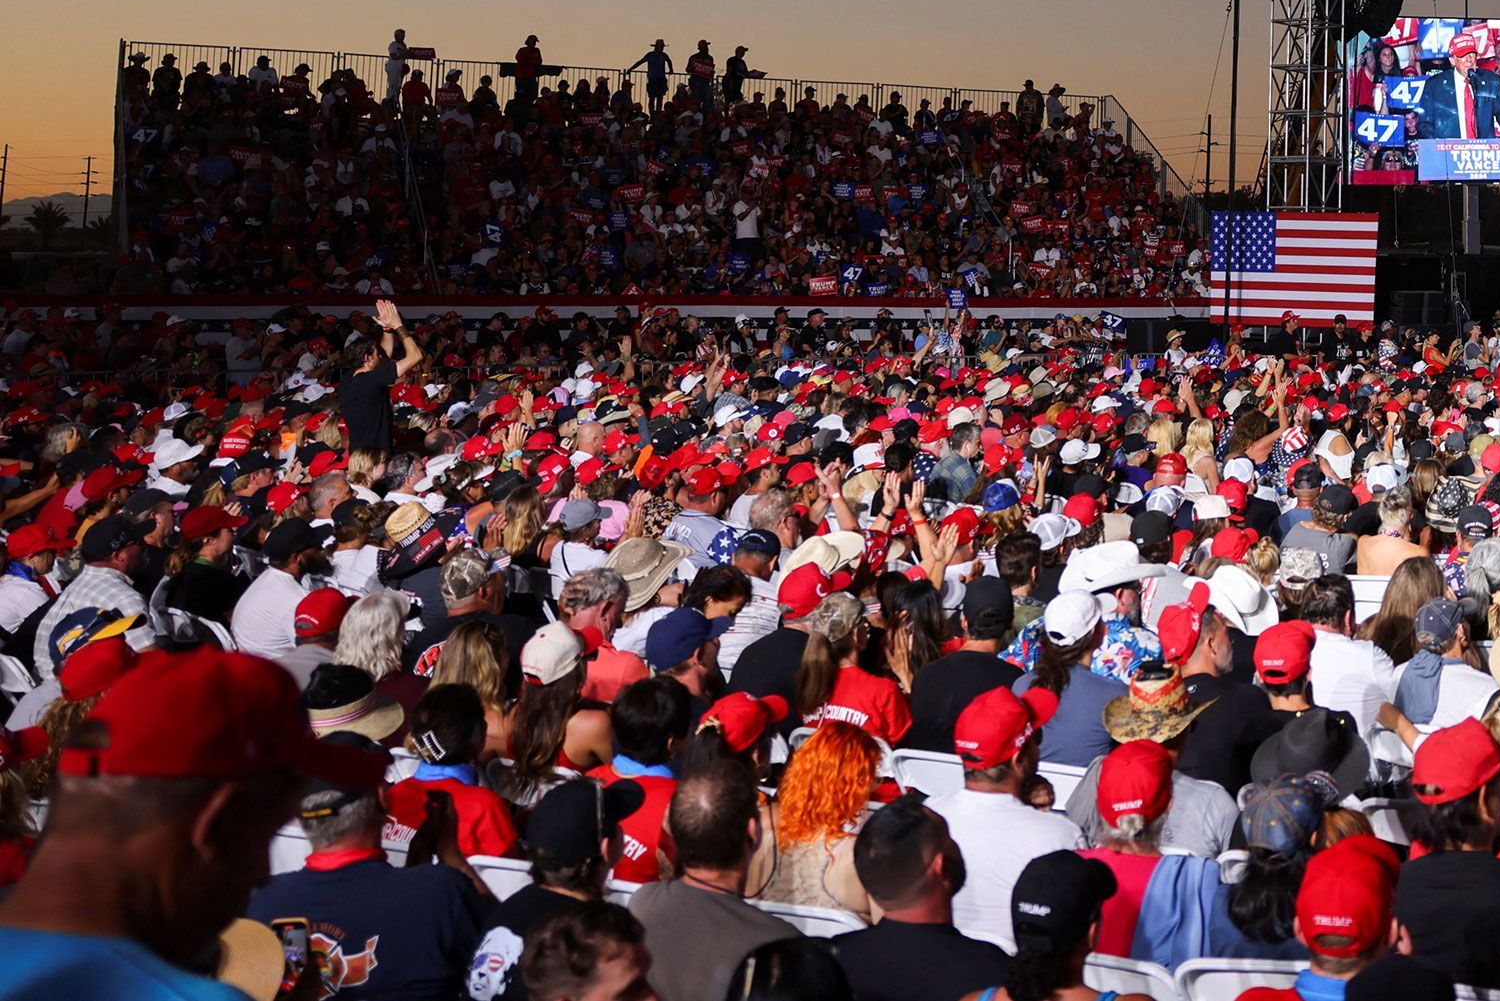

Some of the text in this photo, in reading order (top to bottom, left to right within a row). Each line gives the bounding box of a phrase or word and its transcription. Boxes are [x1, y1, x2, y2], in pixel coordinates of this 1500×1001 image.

[1421, 26, 1455, 53] 47
[1390, 80, 1426, 104] 47
[132, 129, 158, 142] 47
[1357, 119, 1398, 142] 47
[1457, 160, 1500, 170] VANCE
[486, 223, 501, 242] 47
[844, 267, 862, 280] 47
[1103, 314, 1122, 328] 47
[400, 529, 422, 549] TRUMP
[1112, 799, 1143, 812] TRUMP
[1018, 902, 1051, 917] TRUMP
[1313, 915, 1353, 927] TRUMP
